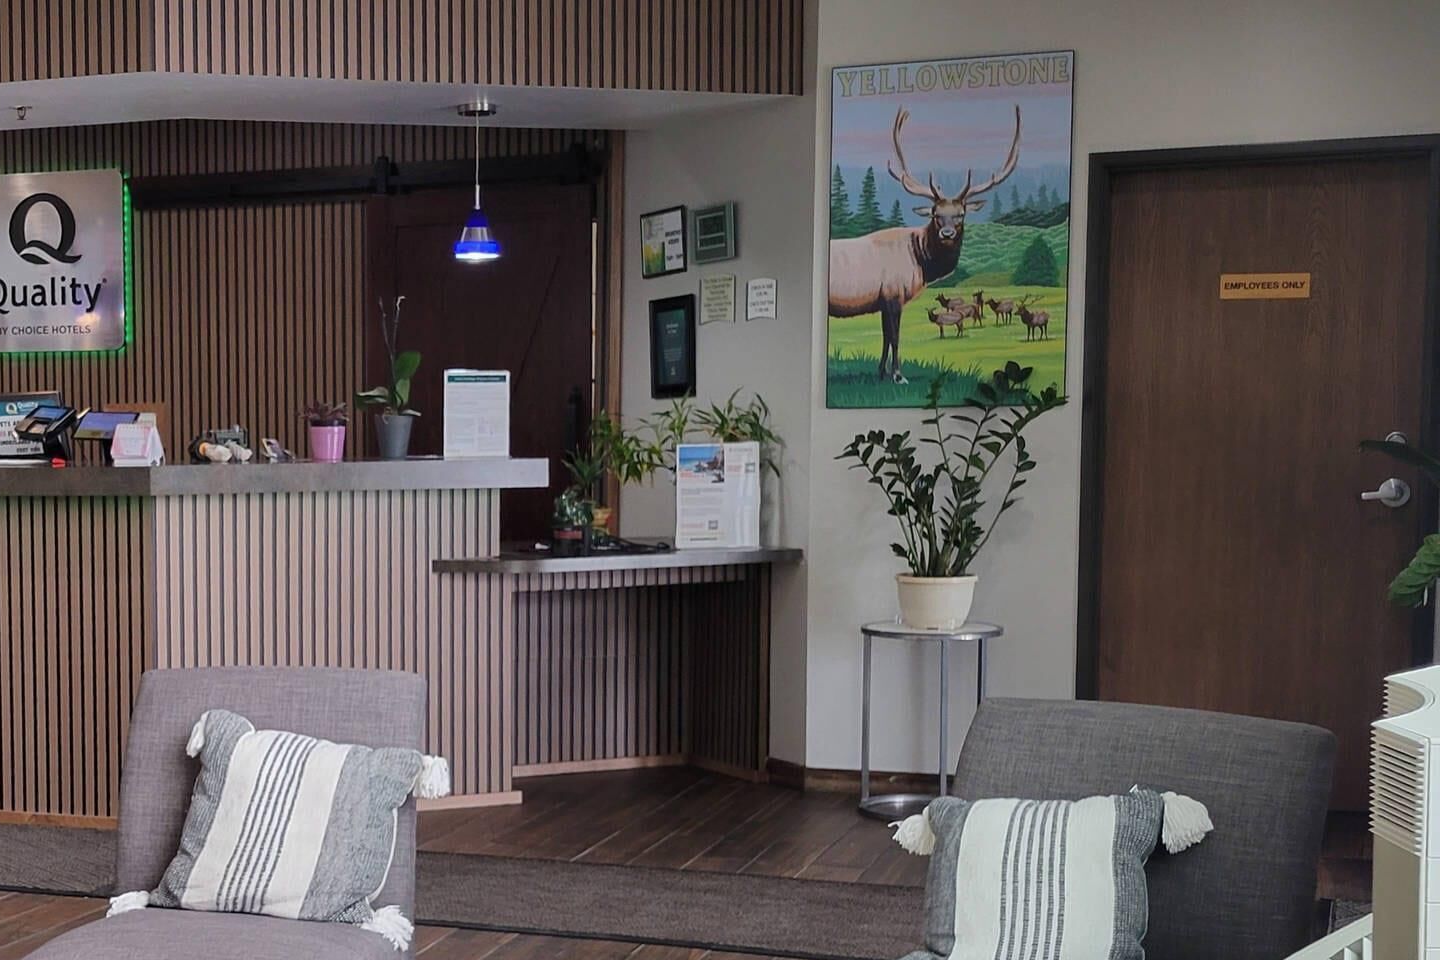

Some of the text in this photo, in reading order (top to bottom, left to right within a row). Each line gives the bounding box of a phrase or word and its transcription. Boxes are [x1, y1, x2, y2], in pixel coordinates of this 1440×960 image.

[836, 56, 1071, 98] YELLOWSTONE
[1224, 281, 1306, 290] EMPLOYEES ONLY
[11, 326, 49, 335] CHOICE
[51, 325, 92, 335] HOTELS
